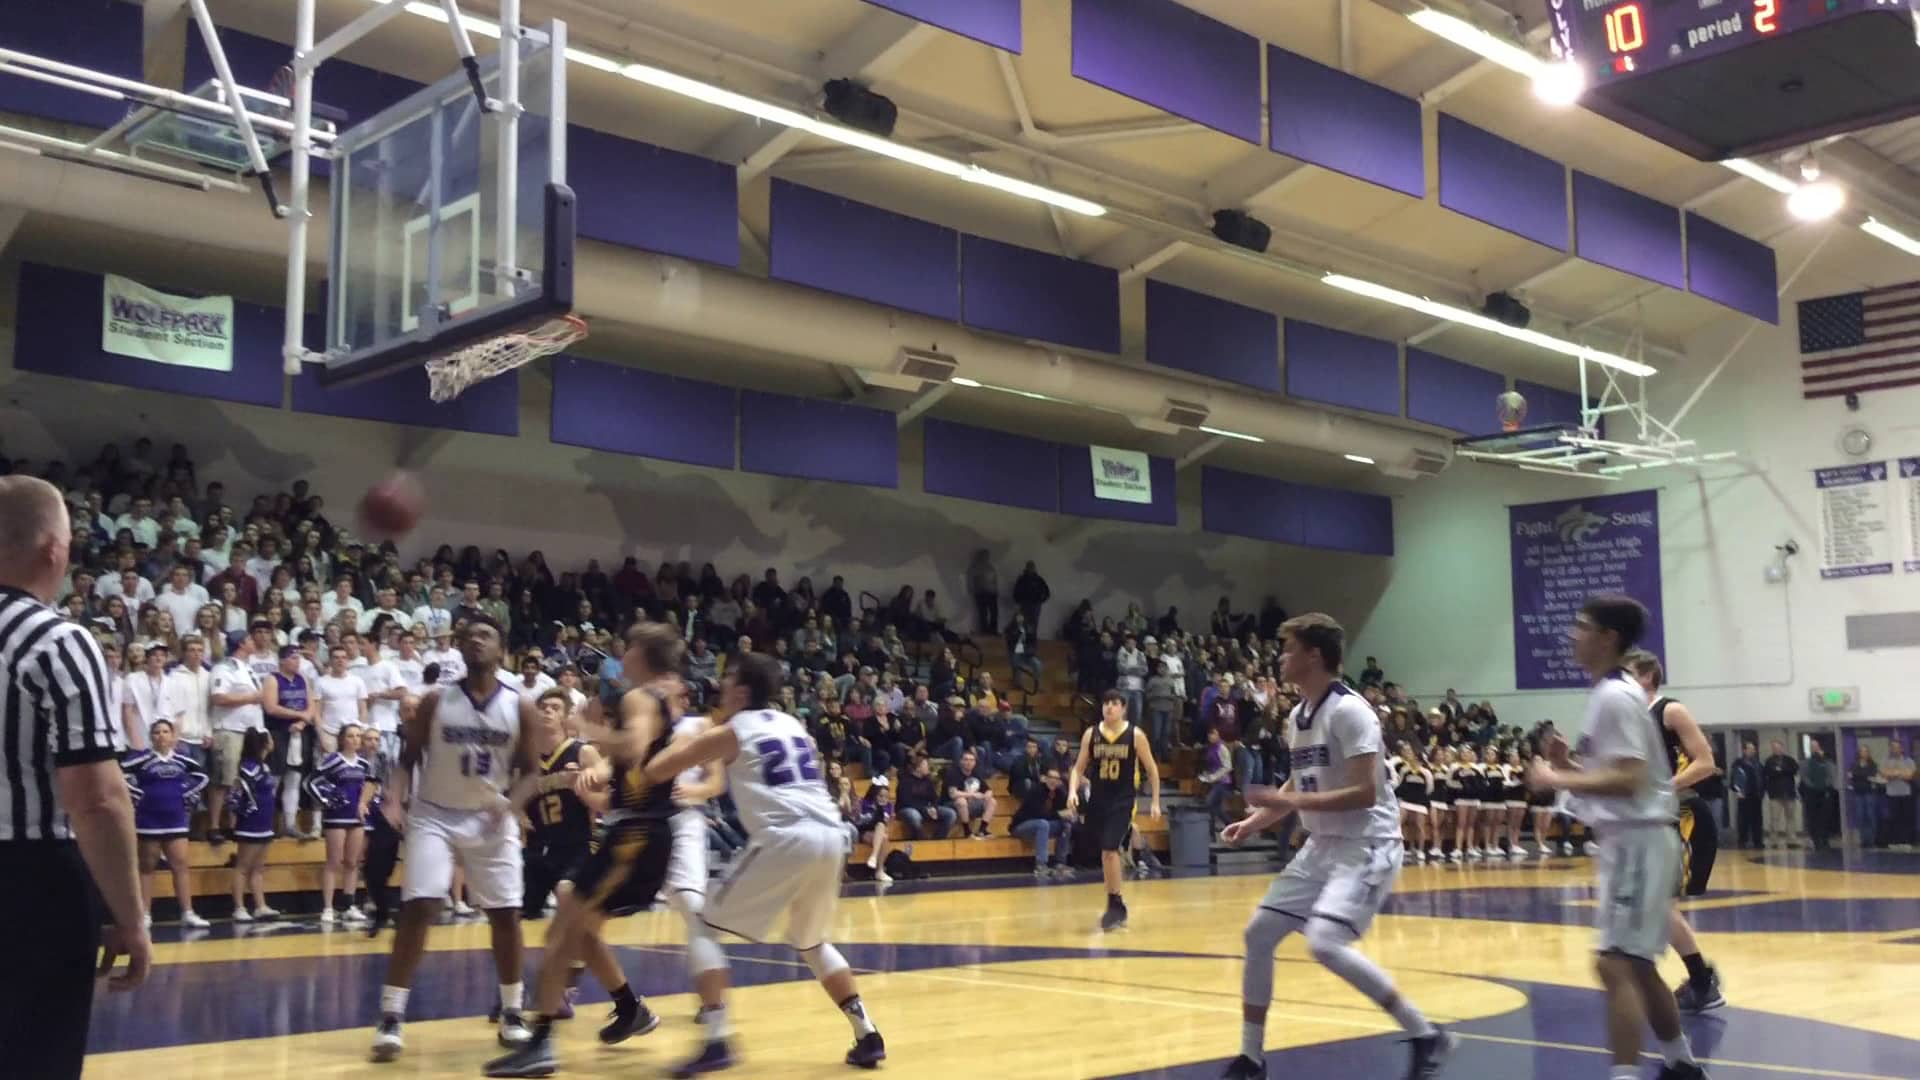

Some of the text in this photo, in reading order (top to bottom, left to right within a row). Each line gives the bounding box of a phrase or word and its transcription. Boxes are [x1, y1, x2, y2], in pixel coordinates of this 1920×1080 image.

[1605, 5, 1643, 53] 10
[1688, 11, 1743, 48] period
[1754, 0, 1776, 32] 2
[109, 321, 225, 350] Student Section
[111, 296, 227, 338] WOLFPACK
[1515, 510, 1653, 536] Fight Song
[756, 735, 820, 786] 22
